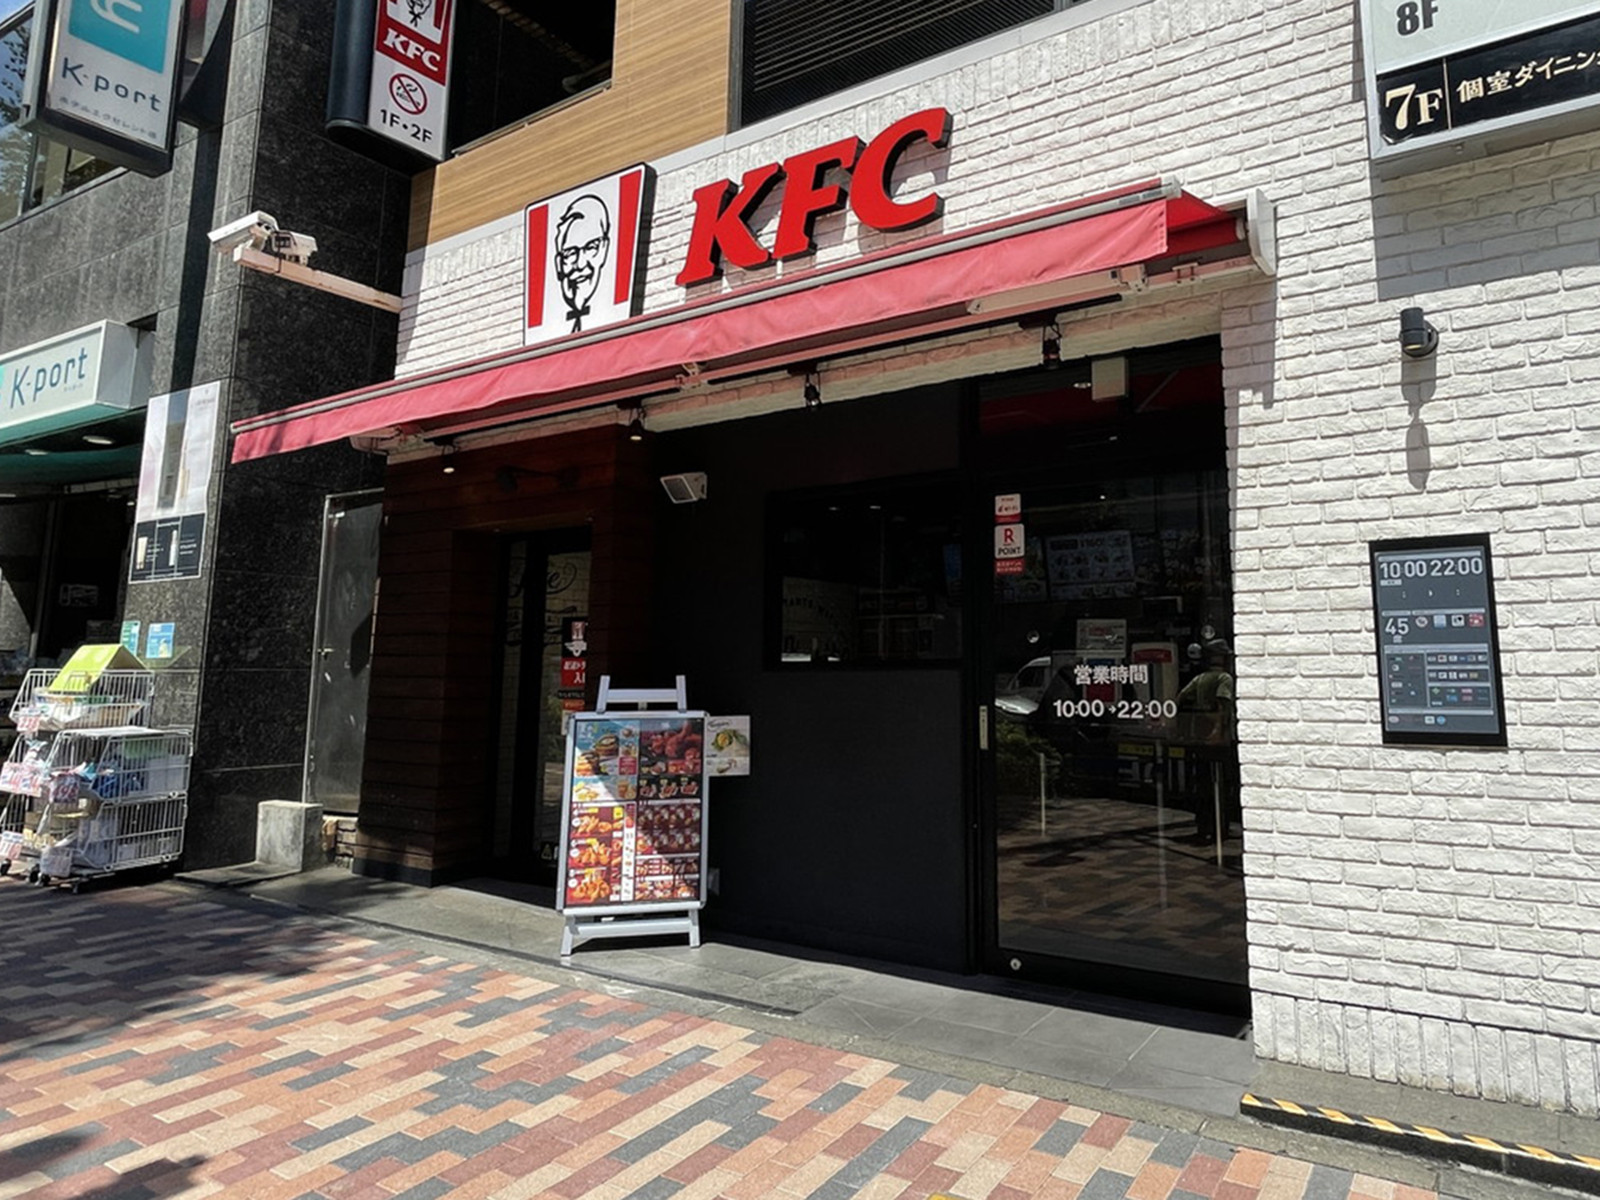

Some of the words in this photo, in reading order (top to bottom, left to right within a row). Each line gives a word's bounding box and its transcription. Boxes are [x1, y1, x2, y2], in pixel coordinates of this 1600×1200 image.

[1396, 0, 1438, 36] 8F
[383, 28, 441, 72] KFC
[1456, 51, 1600, 103] 個室ダイニン
[1385, 84, 1443, 130] 7F
[675, 107, 952, 287] KFC
[998, 547, 1021, 556] POINT
[1385, 617, 1409, 634] 45
[1074, 664, 1149, 685] 営業時間
